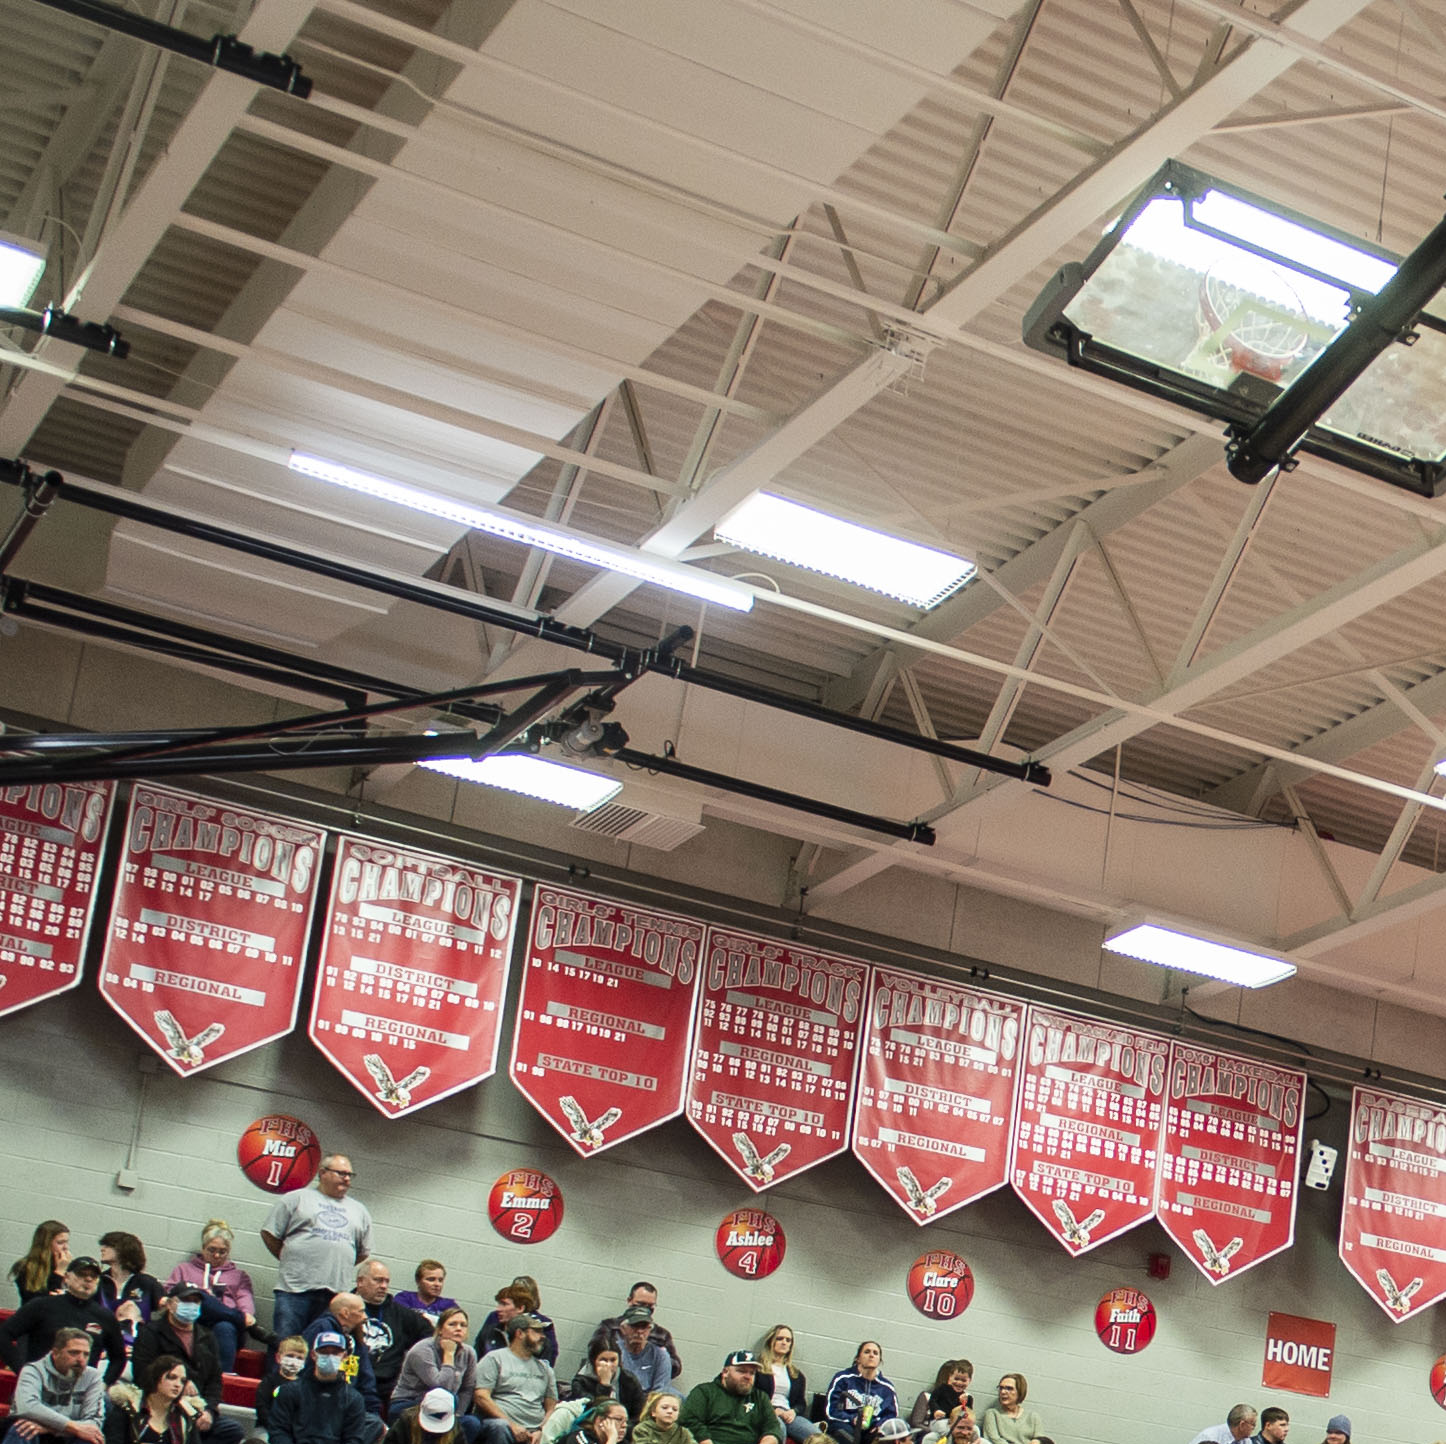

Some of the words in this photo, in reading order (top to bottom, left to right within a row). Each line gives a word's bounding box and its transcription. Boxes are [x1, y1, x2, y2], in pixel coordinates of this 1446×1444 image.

[131, 807, 313, 894] CHAMPIONS
[186, 863, 253, 888] LEAGUE
[351, 846, 510, 895] SOFTBALL
[339, 858, 511, 940] CHAMPIONS
[393, 912, 456, 935] LEAGUE
[541, 892, 615, 918] GIRLS'
[621, 911, 701, 940] TENNIS
[167, 915, 251, 945] DISTRICT
[535, 905, 696, 984] CHAMPIONS
[584, 957, 645, 980] LEAGUE
[713, 935, 784, 960] GIRLS'
[789, 952, 864, 981] TRACK
[155, 970, 242, 1000] REGIONAL
[376, 963, 456, 990] DISTRICT
[709, 948, 860, 1023] CHAMPIONS
[755, 998, 812, 1019] LEAGUE
[881, 974, 1017, 1018] VOLLEYBALL
[365, 1017, 447, 1044] REGIONAL
[568, 1008, 646, 1034] REGIONAL
[874, 987, 1017, 1060] CHAMPIONS
[918, 1036, 971, 1056] LEAGUE
[740, 1047, 813, 1071] REGIONAL
[1029, 1024, 1165, 1095] CHAMPIONS
[542, 1056, 592, 1076] STATE
[599, 1067, 628, 1082] TOP
[636, 1076, 654, 1089] 10
[1071, 1072, 1121, 1092] LEAGUE
[1218, 1058, 1300, 1088] BASKETBALL
[906, 1084, 972, 1107] DISTRICT
[1172, 1060, 1298, 1128] CHAMPIONS
[716, 1094, 763, 1112] STATE
[769, 1105, 797, 1120] TOP
[804, 1113, 821, 1124] 10
[1211, 1105, 1258, 1124] LEAGUE
[260, 1119, 311, 1145] FHS
[1059, 1119, 1123, 1141] REGIONAL
[262, 1139, 296, 1157] Mia
[898, 1133, 967, 1156] REGIONAL
[1200, 1151, 1259, 1172] DISTRICT
[1392, 1150, 1437, 1168] LEAGUE
[267, 1161, 282, 1186] 1
[507, 1173, 554, 1197] FHS
[1038, 1163, 1080, 1180] STATE
[1085, 1173, 1109, 1188] TOP
[1115, 1181, 1131, 1192] 10
[501, 1192, 550, 1209] Emma
[1193, 1198, 1256, 1219] REGIONAL
[1383, 1193, 1438, 1213] DISTRICT
[511, 1213, 533, 1238] 2
[732, 1212, 775, 1234] FHS
[726, 1231, 773, 1246] Ashlee
[1376, 1238, 1434, 1259] REGIONAL
[739, 1251, 757, 1274] 4
[924, 1254, 965, 1277] FHS
[923, 1272, 958, 1287] Clare
[924, 1290, 955, 1315] 10
[1111, 1289, 1148, 1312] FHS
[1109, 1309, 1140, 1322] Faith
[1110, 1325, 1136, 1350] 11
[1267, 1338, 1331, 1371] HOME
